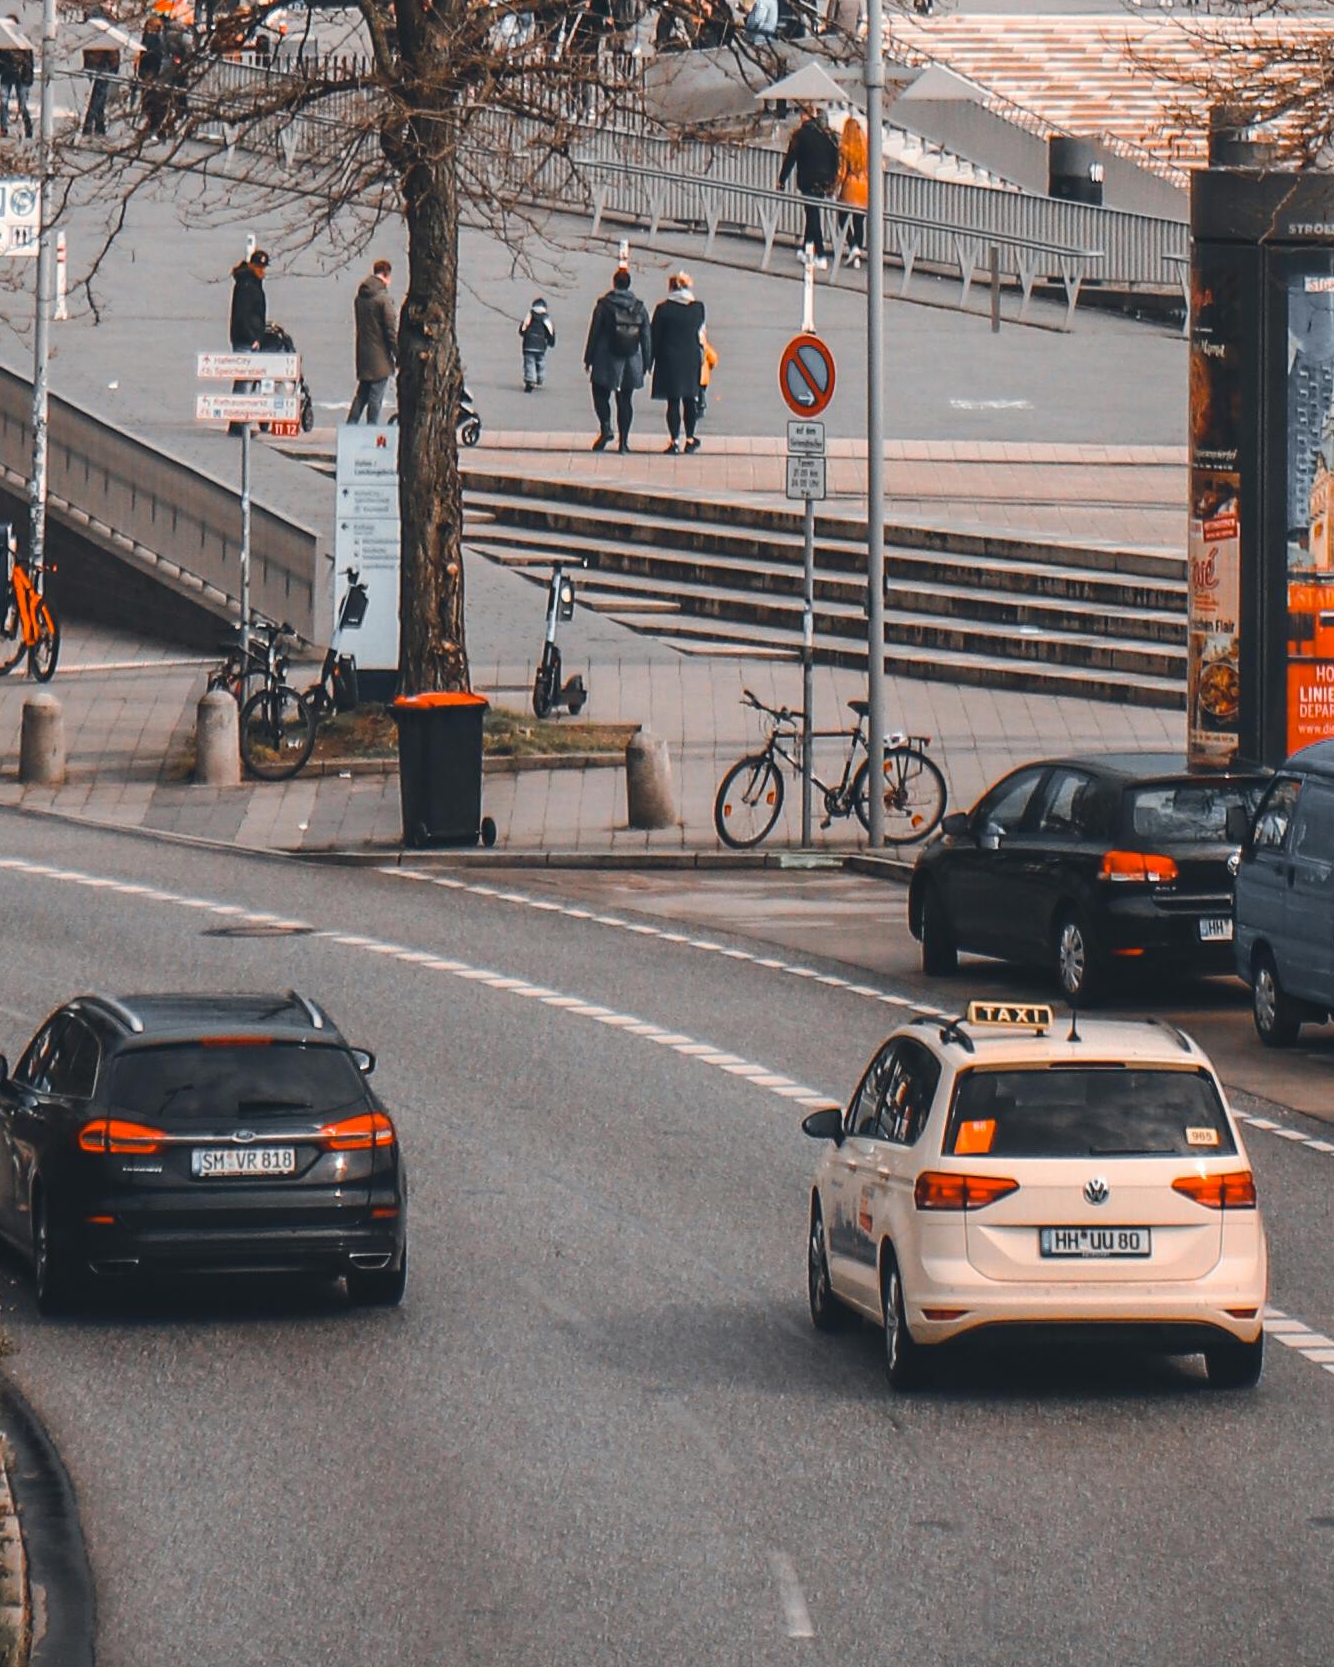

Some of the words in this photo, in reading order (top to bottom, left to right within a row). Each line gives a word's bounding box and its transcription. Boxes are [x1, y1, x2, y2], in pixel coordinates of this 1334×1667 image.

[287, 424, 297, 435] 12
[982, 1006, 1040, 1024] TAXI
[1191, 1131, 1213, 1142] 965
[202, 1154, 225, 1170] SM
[235, 1152, 257, 1168] VR
[261, 1151, 293, 1168] 818
[1055, 1234, 1079, 1250] HH
[1090, 1234, 1114, 1250] UU
[1118, 1233, 1140, 1250] 80
